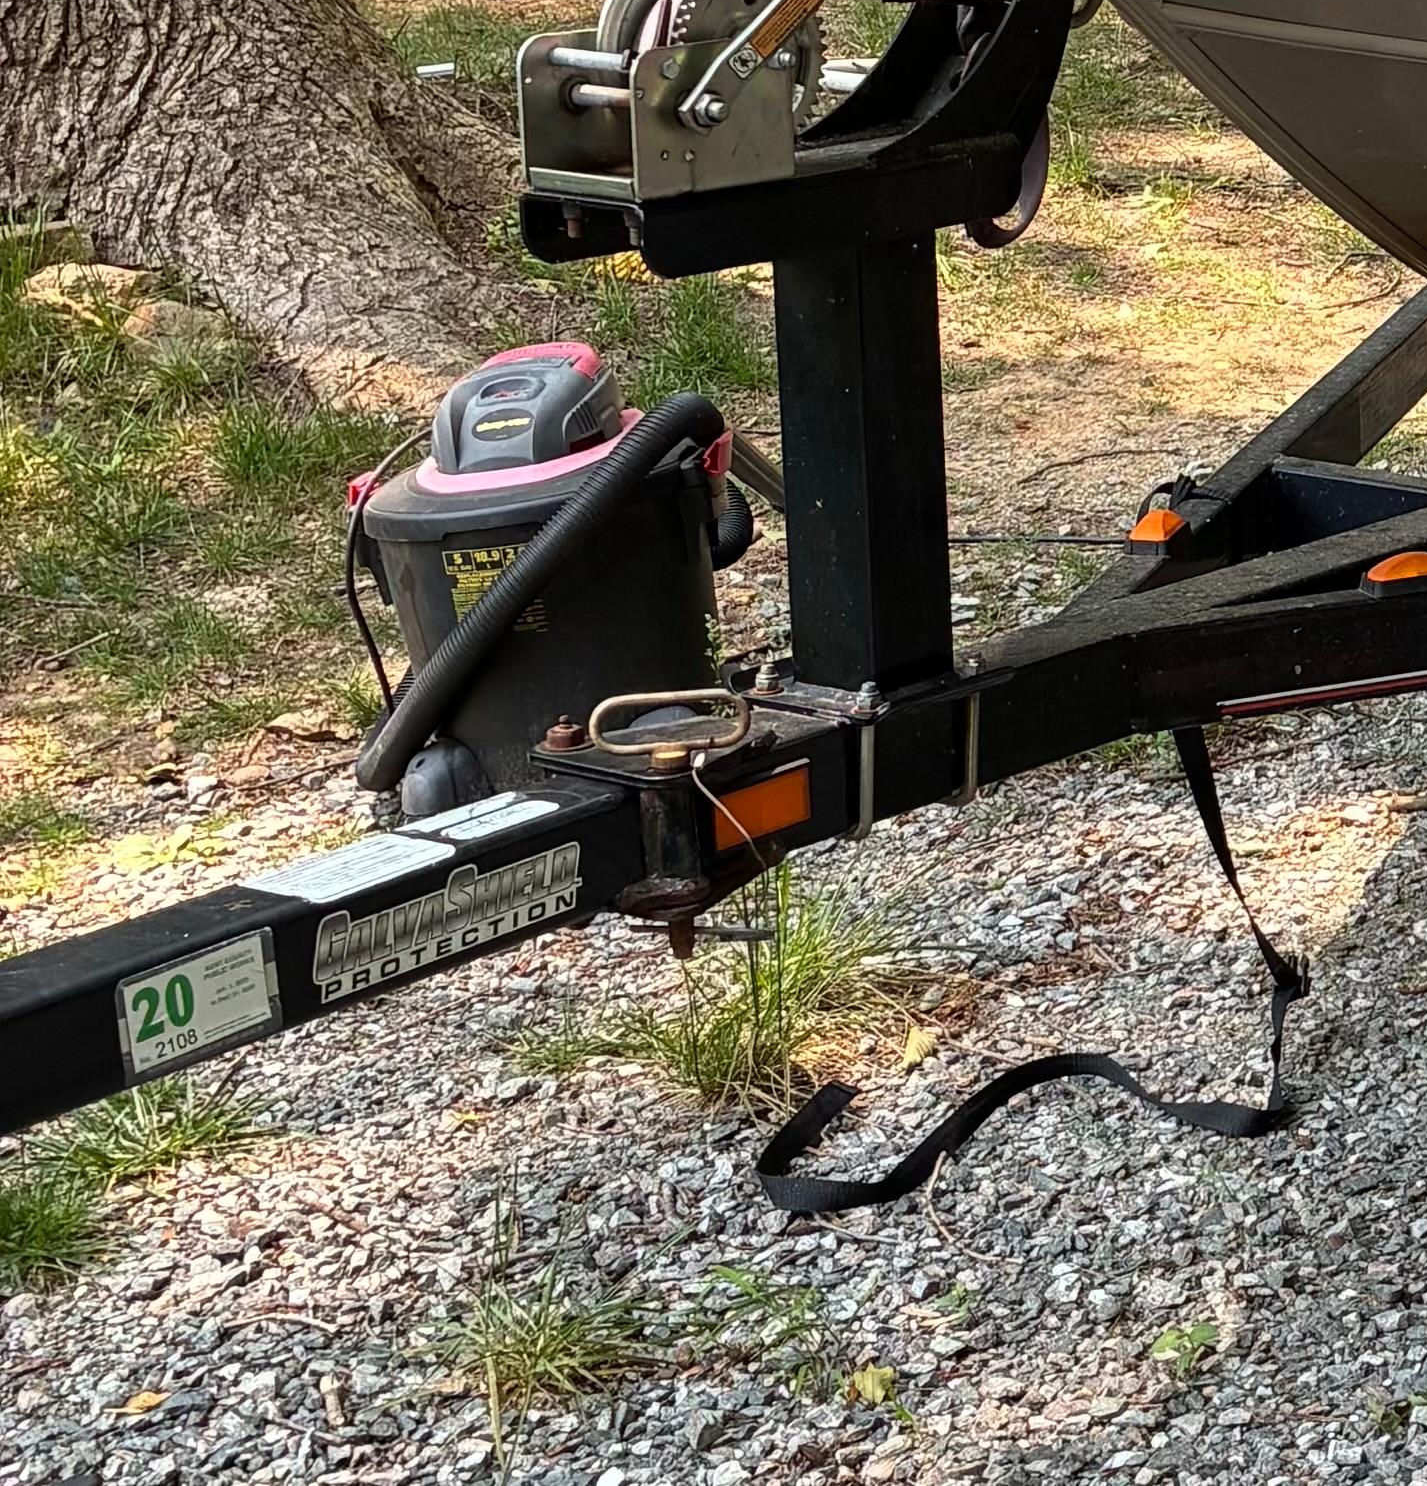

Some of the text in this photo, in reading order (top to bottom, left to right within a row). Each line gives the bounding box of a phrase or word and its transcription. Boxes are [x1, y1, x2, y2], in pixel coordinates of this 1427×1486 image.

[324, 890, 575, 1001] PROTECTION
[132, 973, 195, 1044] 20
[155, 1028, 199, 1059] 2108
